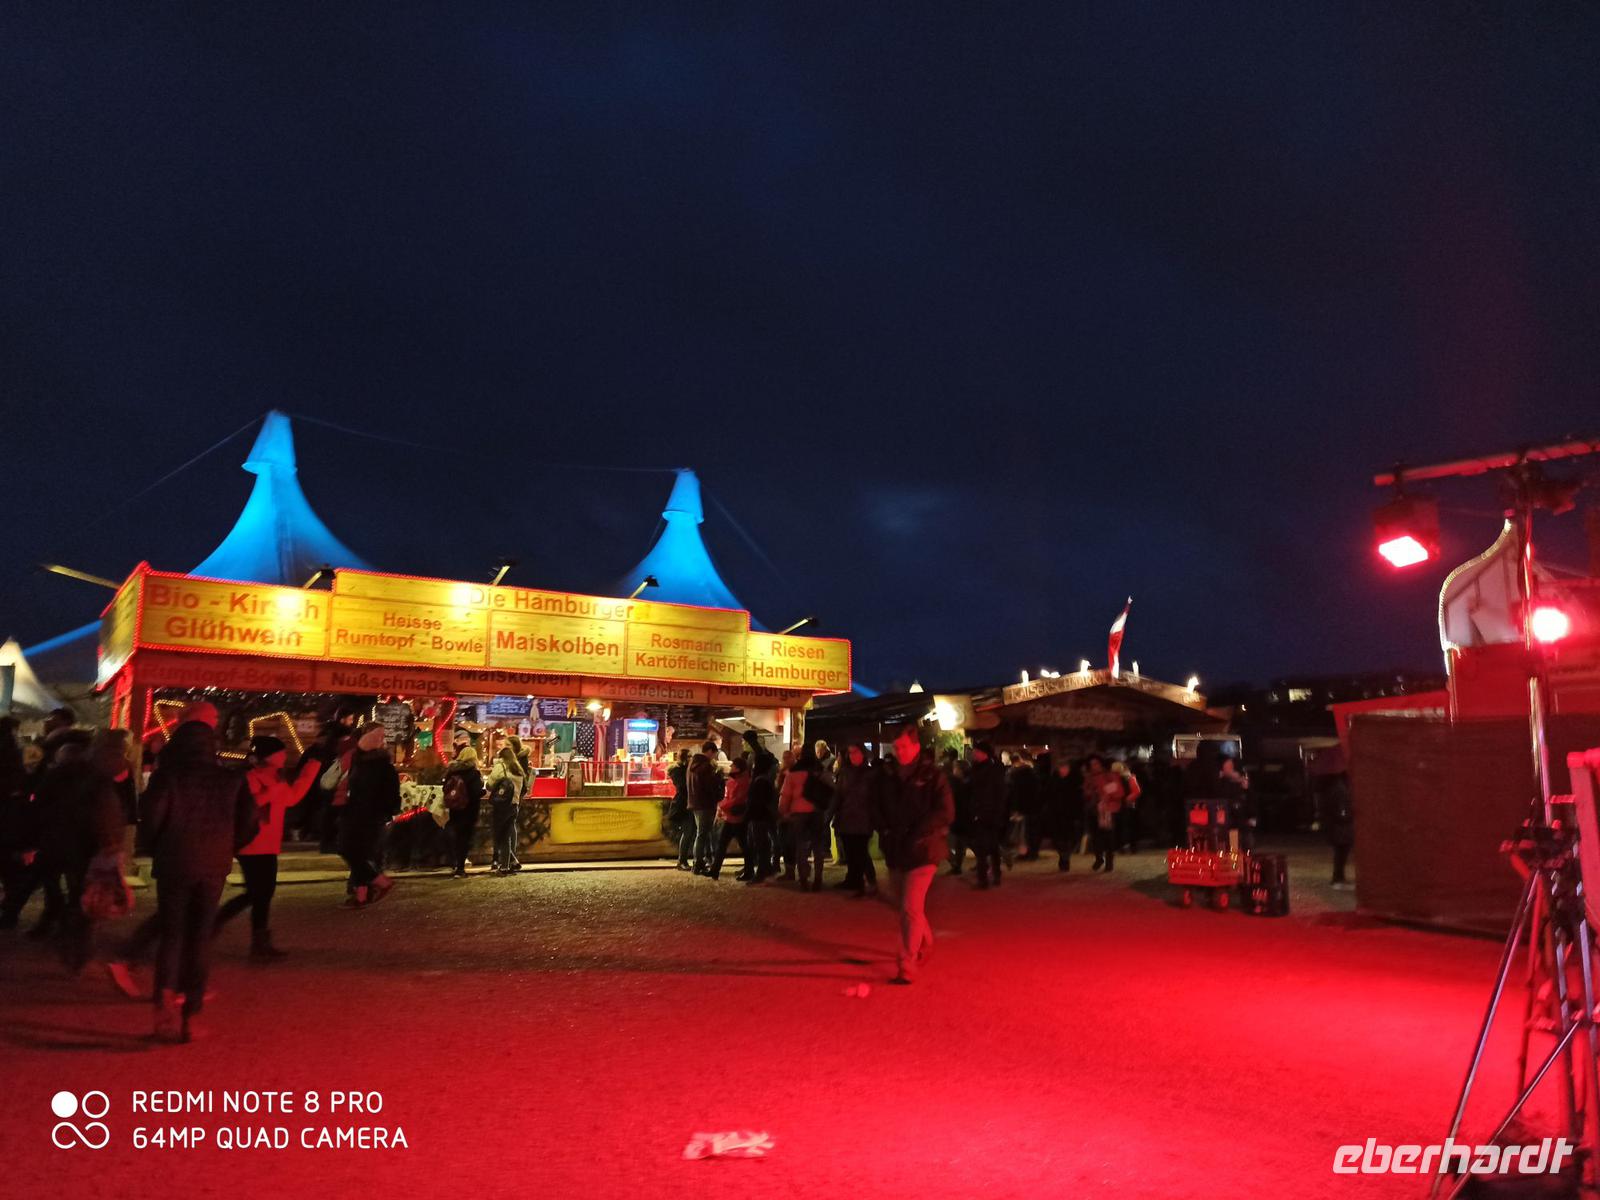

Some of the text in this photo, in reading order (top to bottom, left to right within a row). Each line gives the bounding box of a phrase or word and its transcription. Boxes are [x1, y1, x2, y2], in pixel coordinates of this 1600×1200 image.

[150, 584, 199, 609] Bio
[470, 588, 635, 619] Die Hamburger
[166, 615, 303, 647] Glühwein
[383, 611, 443, 630] Heisse
[336, 629, 415, 650] Rumtopf
[431, 636, 484, 653] Bowle
[496, 630, 619, 657] Maiskolben
[651, 633, 723, 653] Rosmarin
[771, 640, 825, 659] Riesen
[752, 661, 841, 685] Hamburger
